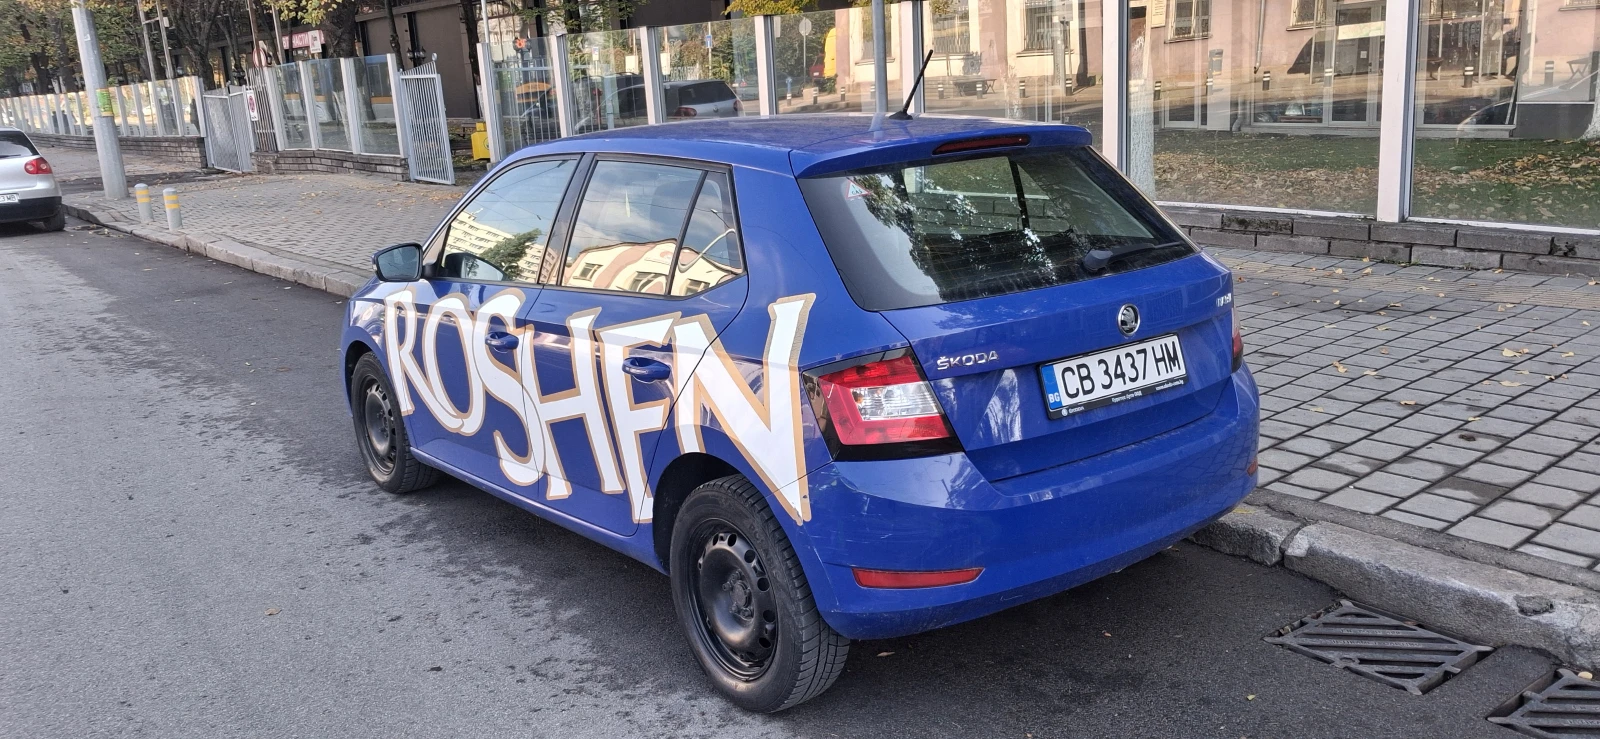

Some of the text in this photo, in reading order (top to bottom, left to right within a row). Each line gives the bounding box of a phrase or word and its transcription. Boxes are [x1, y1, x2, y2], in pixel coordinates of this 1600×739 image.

[937, 350, 999, 371] ŠKODA
[1061, 341, 1181, 398] CB 3437 HM
[1048, 392, 1060, 403] BG
